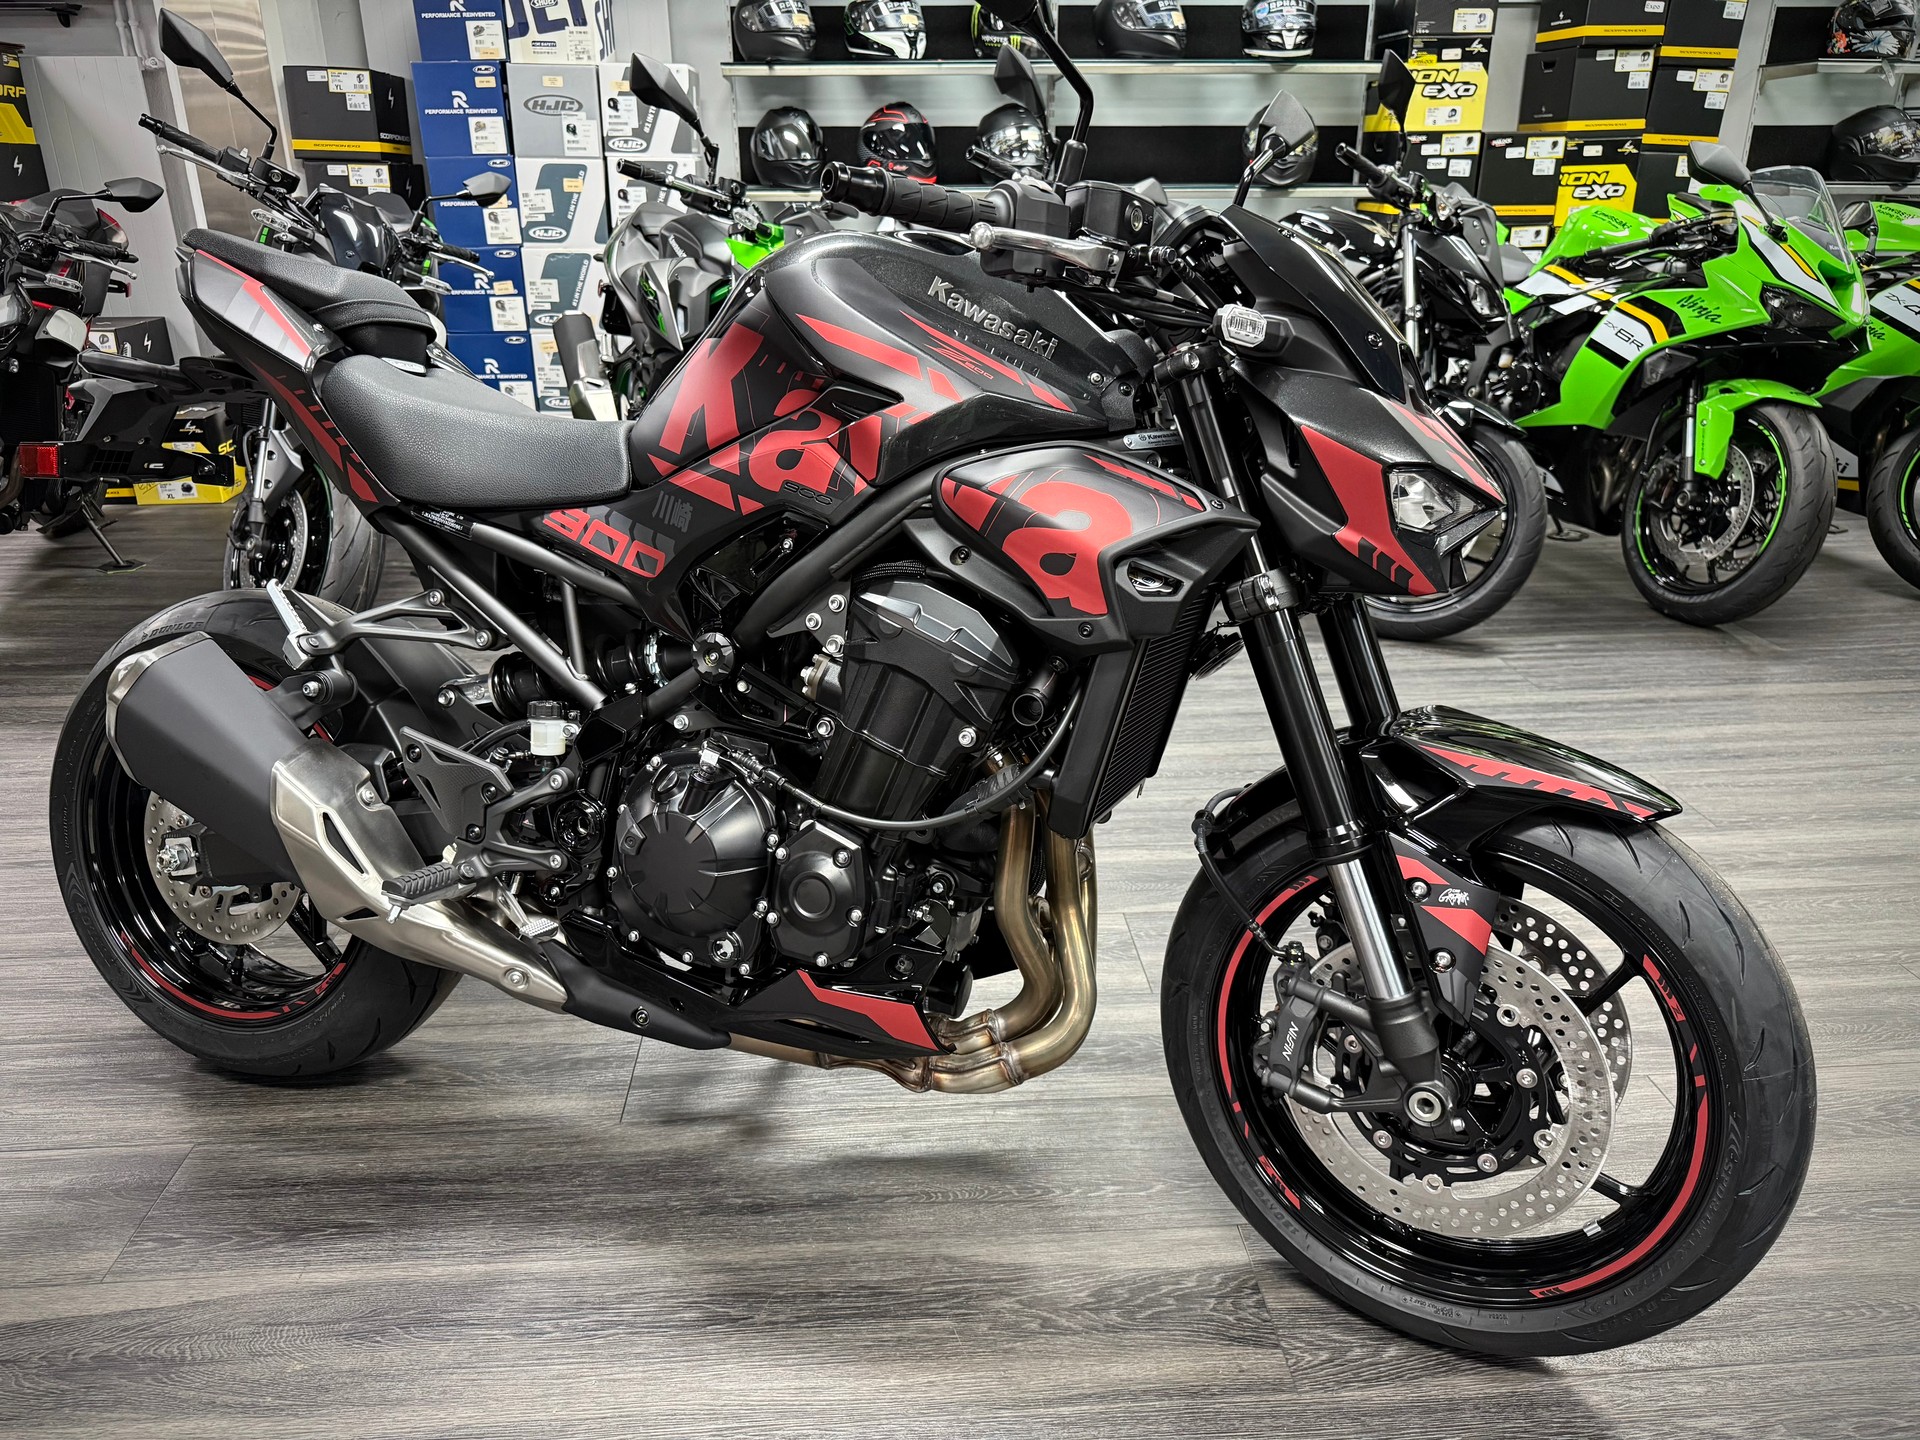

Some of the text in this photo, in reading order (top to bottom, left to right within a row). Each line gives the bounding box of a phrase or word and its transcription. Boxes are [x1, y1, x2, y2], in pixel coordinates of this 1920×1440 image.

[1422, 83, 1478, 99] EXO
[531, 100, 575, 111] HJC
[613, 141, 641, 149] HJC
[1573, 184, 1626, 200] EXO
[535, 229, 560, 237] HJC
[578, 259, 589, 281] WORLD
[927, 275, 1059, 360] Kawasaki
[1676, 294, 1722, 324] Ninja
[783, 481, 833, 505] 900
[1282, 1021, 1299, 1062] NISSIN
